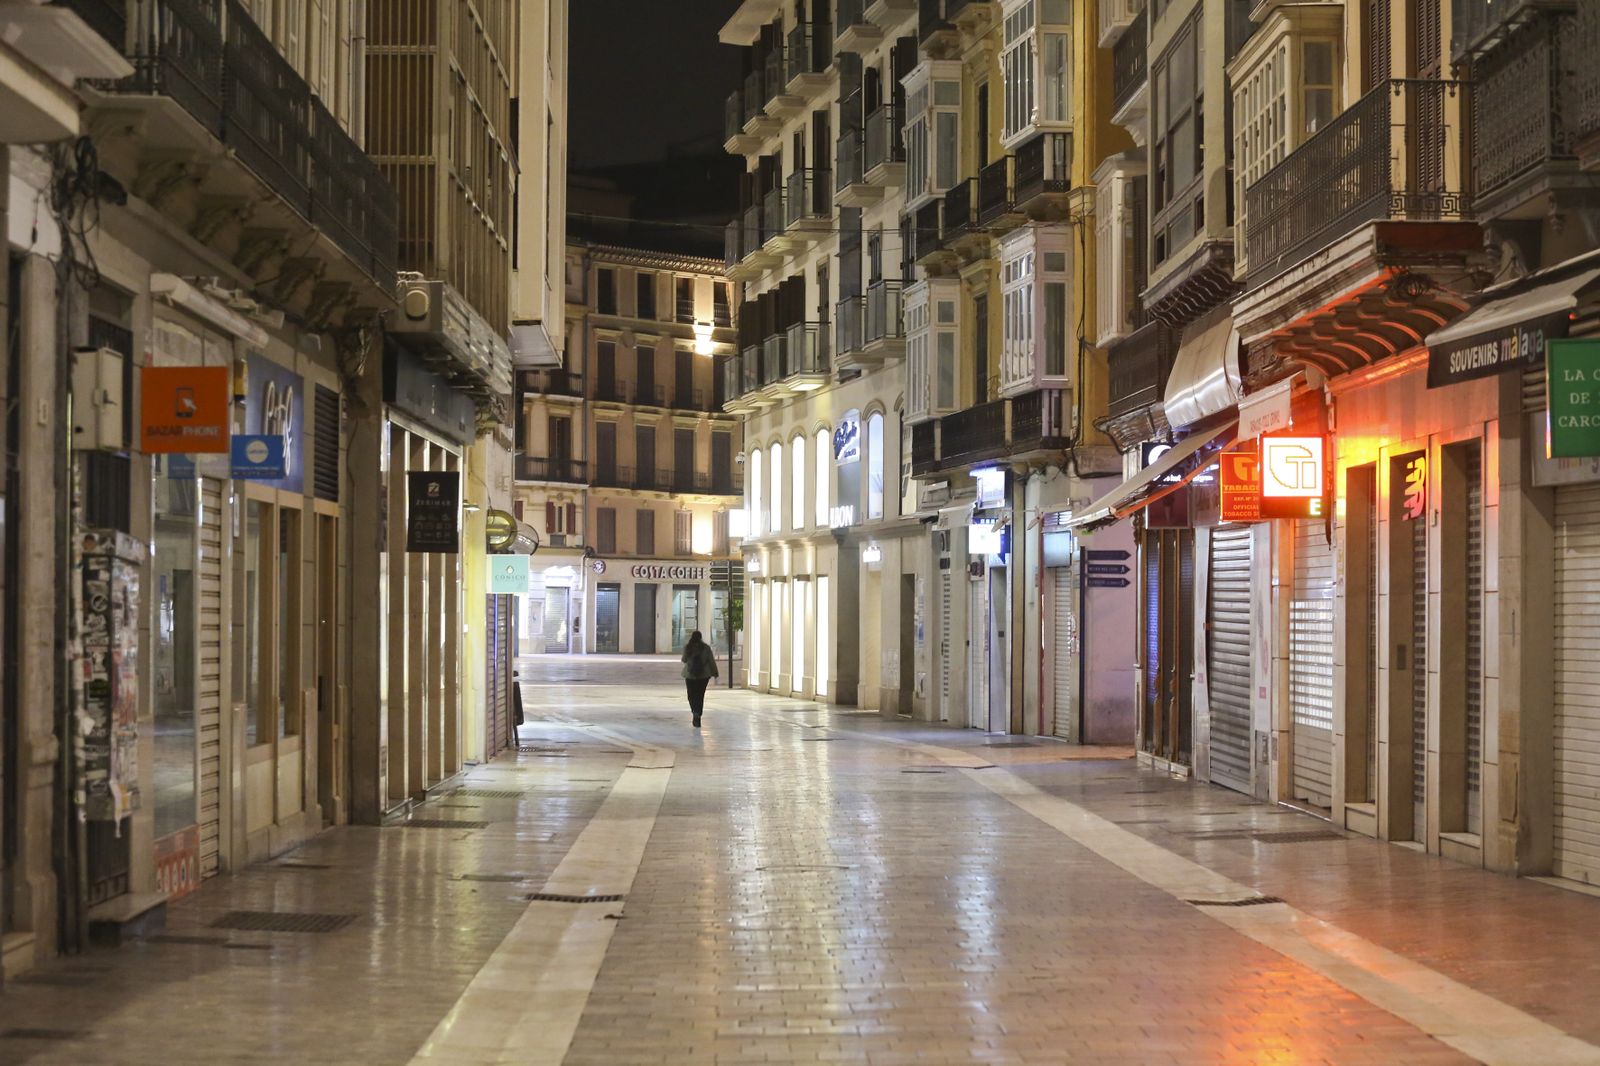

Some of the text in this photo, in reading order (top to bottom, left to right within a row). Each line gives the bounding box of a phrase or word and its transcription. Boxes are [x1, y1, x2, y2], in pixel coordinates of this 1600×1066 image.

[1450, 341, 1498, 373] SOUVENIRS
[1564, 369, 1585, 381] LA
[1570, 392, 1590, 405] DE
[632, 565, 667, 579] COSTA
